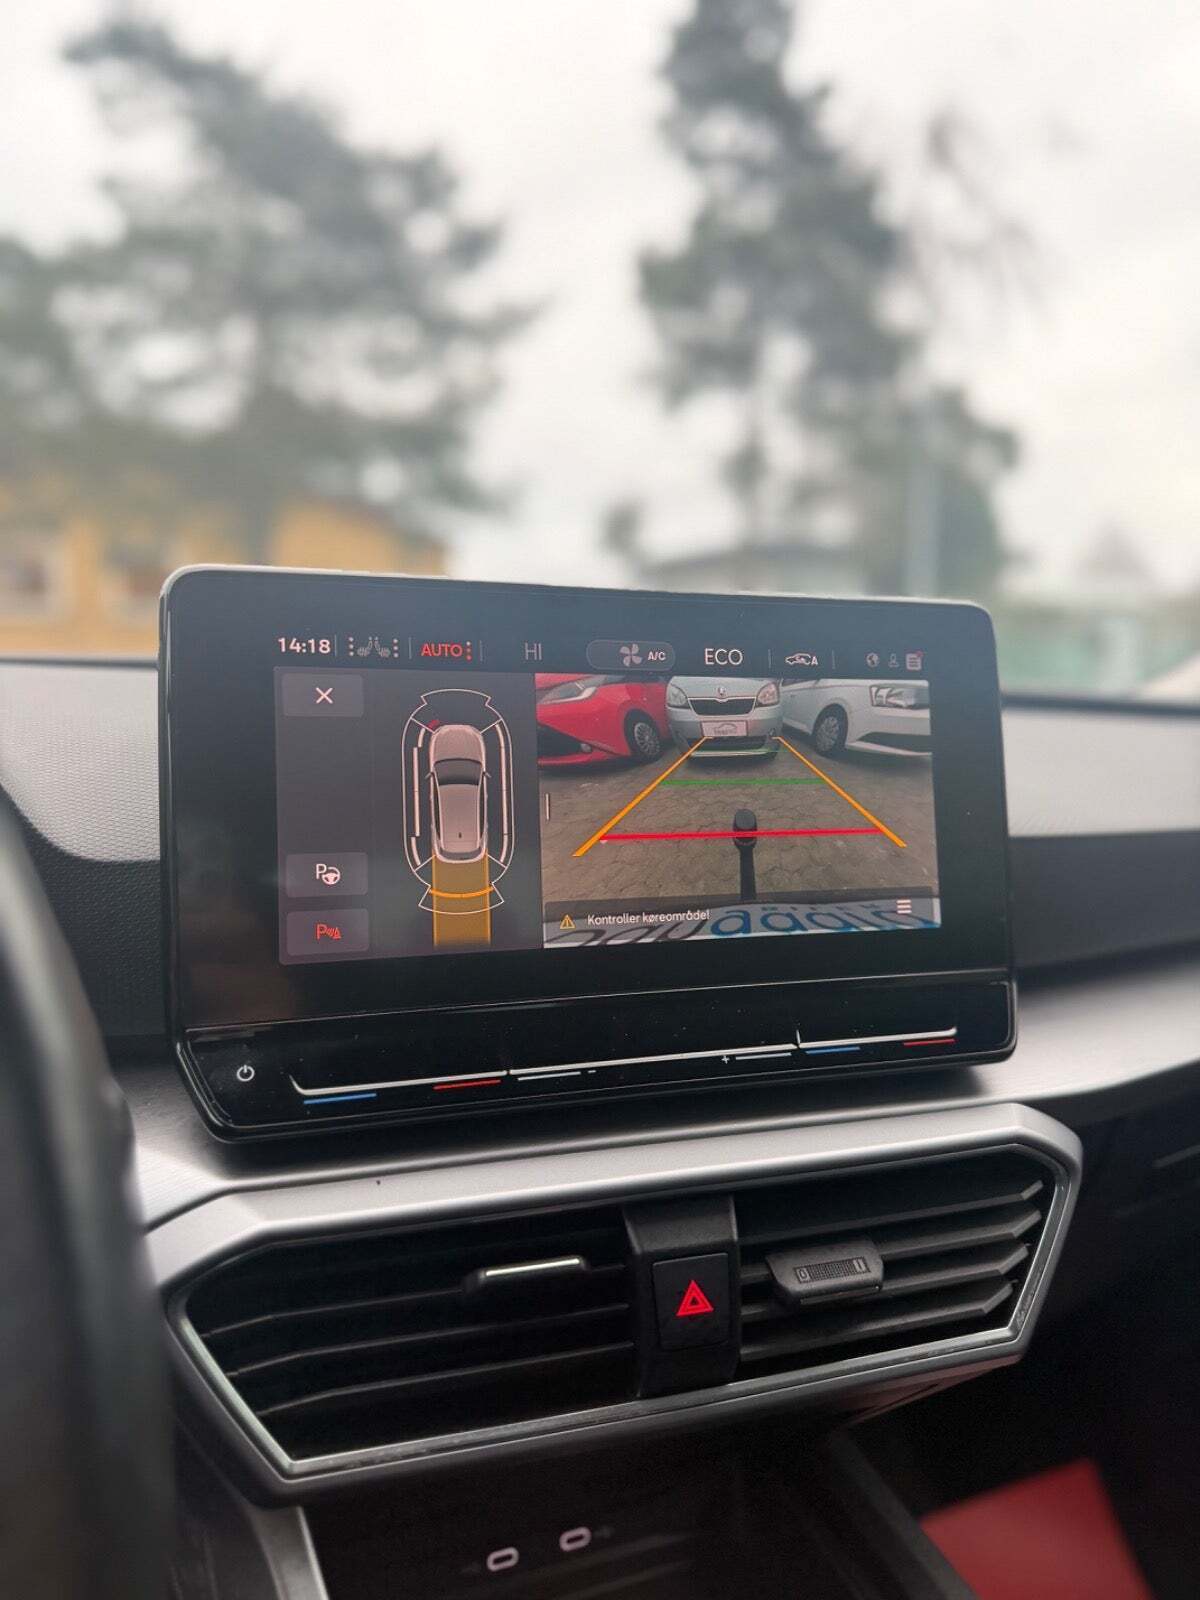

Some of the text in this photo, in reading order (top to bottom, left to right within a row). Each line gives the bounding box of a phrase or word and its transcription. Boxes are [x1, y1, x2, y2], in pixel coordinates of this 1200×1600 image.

[278, 637, 331, 654] 14:18
[421, 643, 463, 657] AUTO
[524, 642, 542, 660] HI
[647, 651, 667, 661] A/C
[705, 648, 743, 665] ECO
[587, 913, 641, 926] Kontroller
